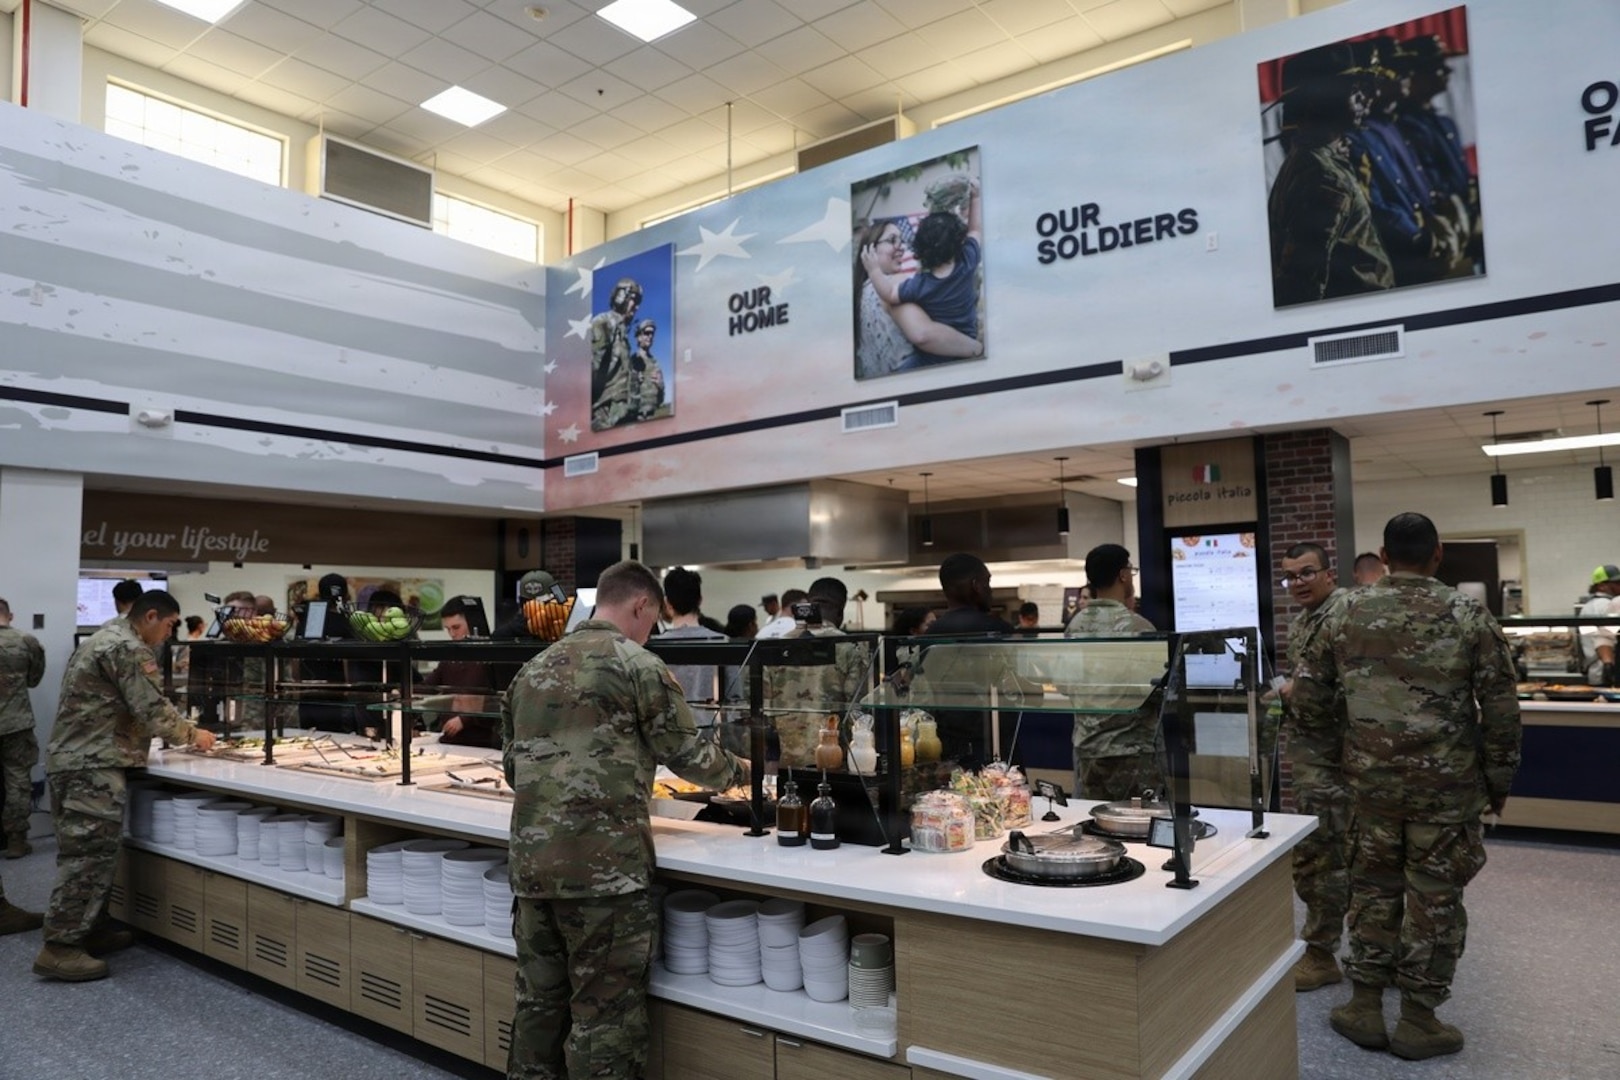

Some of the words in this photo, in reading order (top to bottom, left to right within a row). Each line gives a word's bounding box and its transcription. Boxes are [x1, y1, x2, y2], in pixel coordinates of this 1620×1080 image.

[1581, 81, 1620, 115] O
[1036, 202, 1100, 238] OUR
[1037, 208, 1199, 265] SOLDIERS
[728, 285, 771, 313] OUR
[729, 302, 789, 336] HOME
[1168, 490, 1211, 506] piccola
[1217, 485, 1251, 499] italia
[81, 522, 107, 546] el
[113, 530, 175, 556] your
[181, 525, 269, 560] lifestyle
